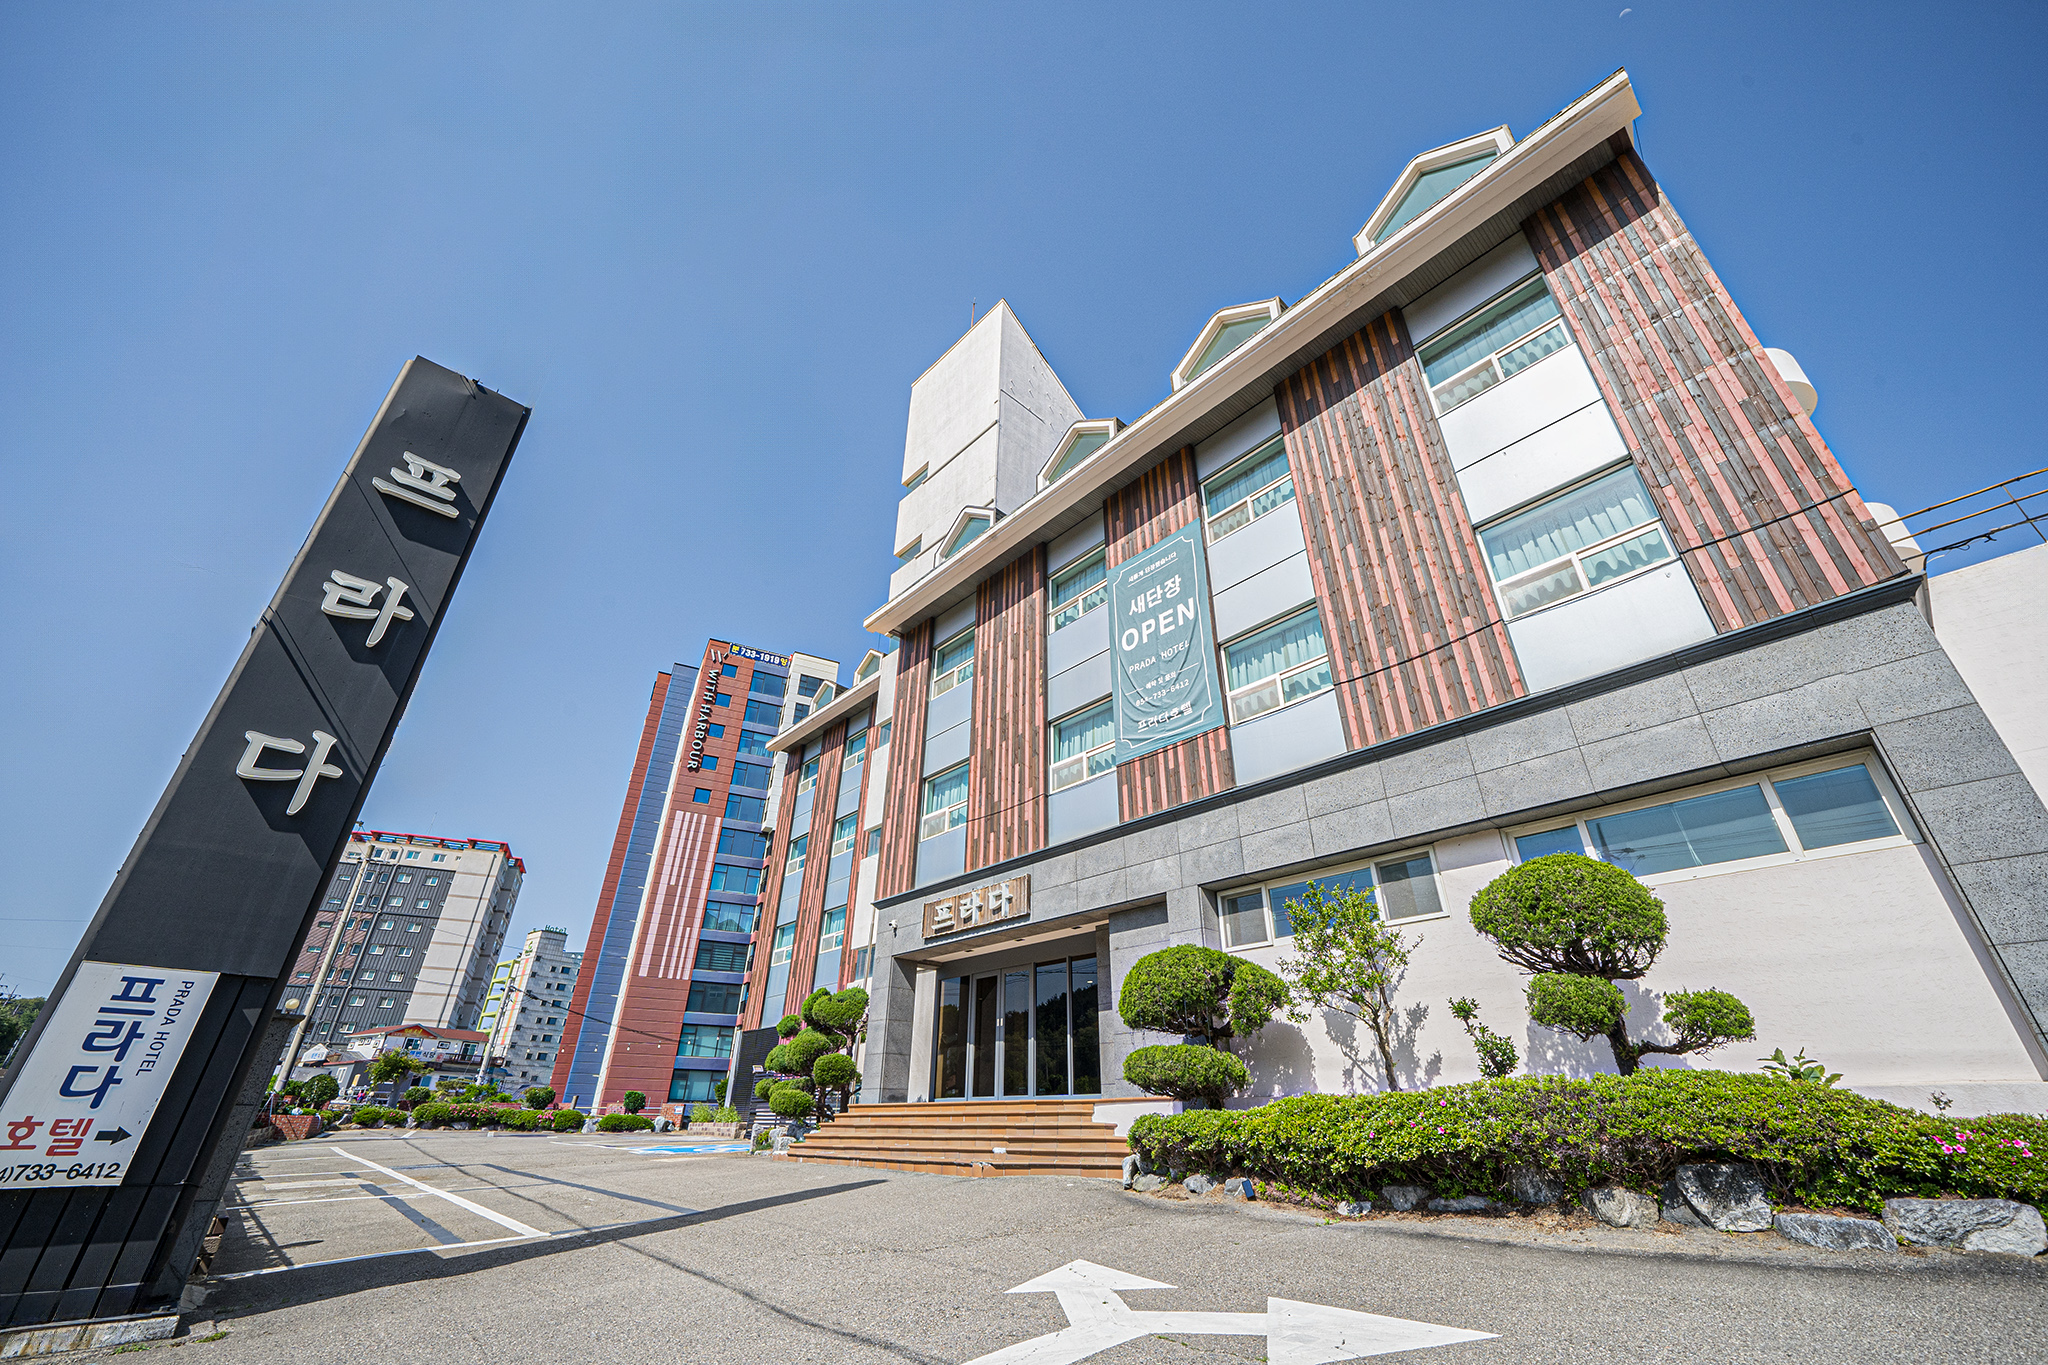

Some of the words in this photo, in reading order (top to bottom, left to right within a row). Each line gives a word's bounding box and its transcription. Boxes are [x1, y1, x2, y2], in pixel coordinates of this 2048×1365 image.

[1128, 574, 1182, 616] 새단장
[236, 450, 461, 815] 프라다
[1121, 597, 1195, 652] OPEN
[741, 647, 780, 664] 733-1919
[1128, 656, 1157, 674] PRADA
[1160, 640, 1190, 660] HOTEL
[703, 669, 720, 701] WITH
[687, 704, 711, 769] HARBOUR
[1137, 701, 1193, 734] 프라다호텔
[931, 882, 1014, 931] 프라다
[544, 924, 567, 934] Hotel
[160, 980, 195, 1027] PRADA
[59, 975, 166, 1110] 프라다
[135, 1031, 170, 1077] HOTEL
[0, 1116, 95, 1157] 호텔
